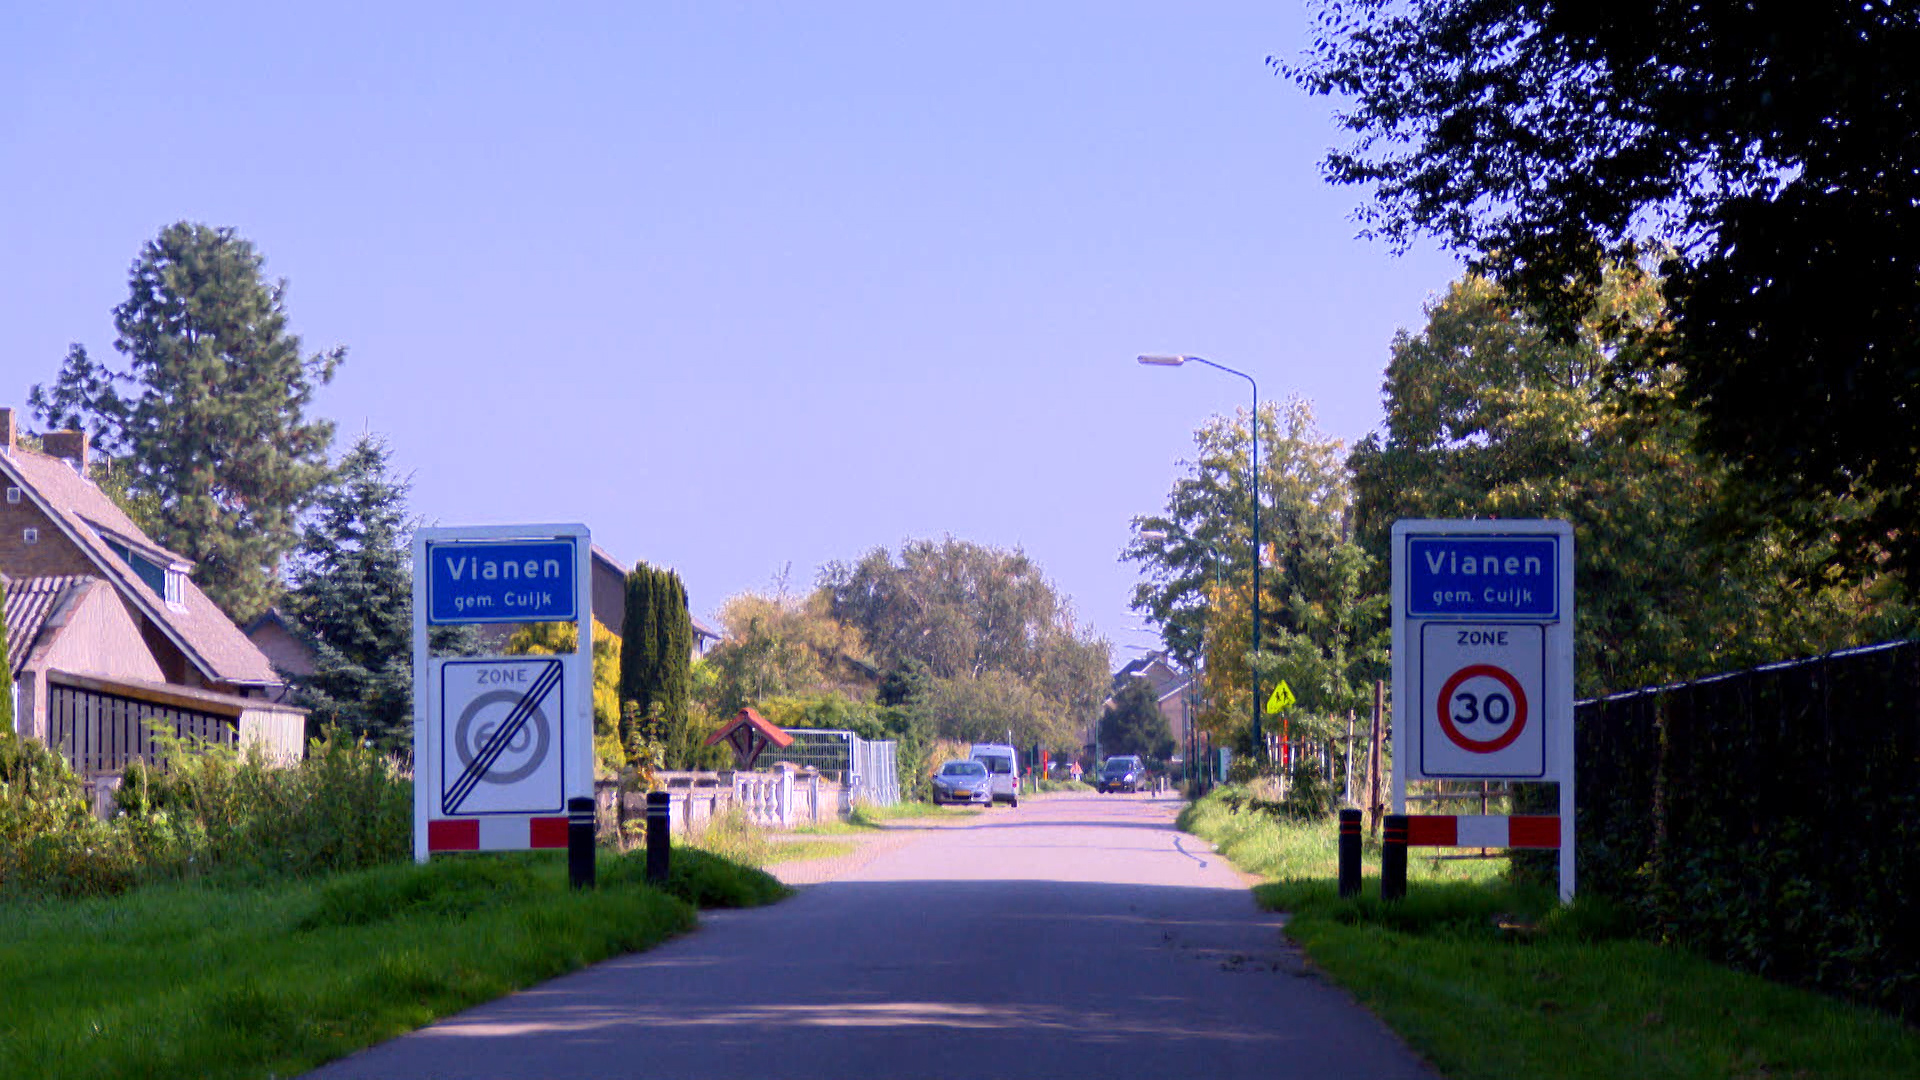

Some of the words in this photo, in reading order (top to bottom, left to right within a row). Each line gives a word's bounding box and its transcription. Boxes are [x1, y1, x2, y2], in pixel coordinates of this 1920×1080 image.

[446, 557, 560, 581] Vianen
[1425, 550, 1541, 575] Vianen
[454, 594, 494, 612] gem.
[504, 591, 553, 610] Cuijk
[1433, 590, 1474, 606] gem.
[1484, 587, 1533, 607] Cuijk
[1457, 631, 1509, 646] ZONE
[477, 669, 528, 684] ZONE
[1454, 693, 1510, 724] 30
[474, 721, 531, 754] 60
